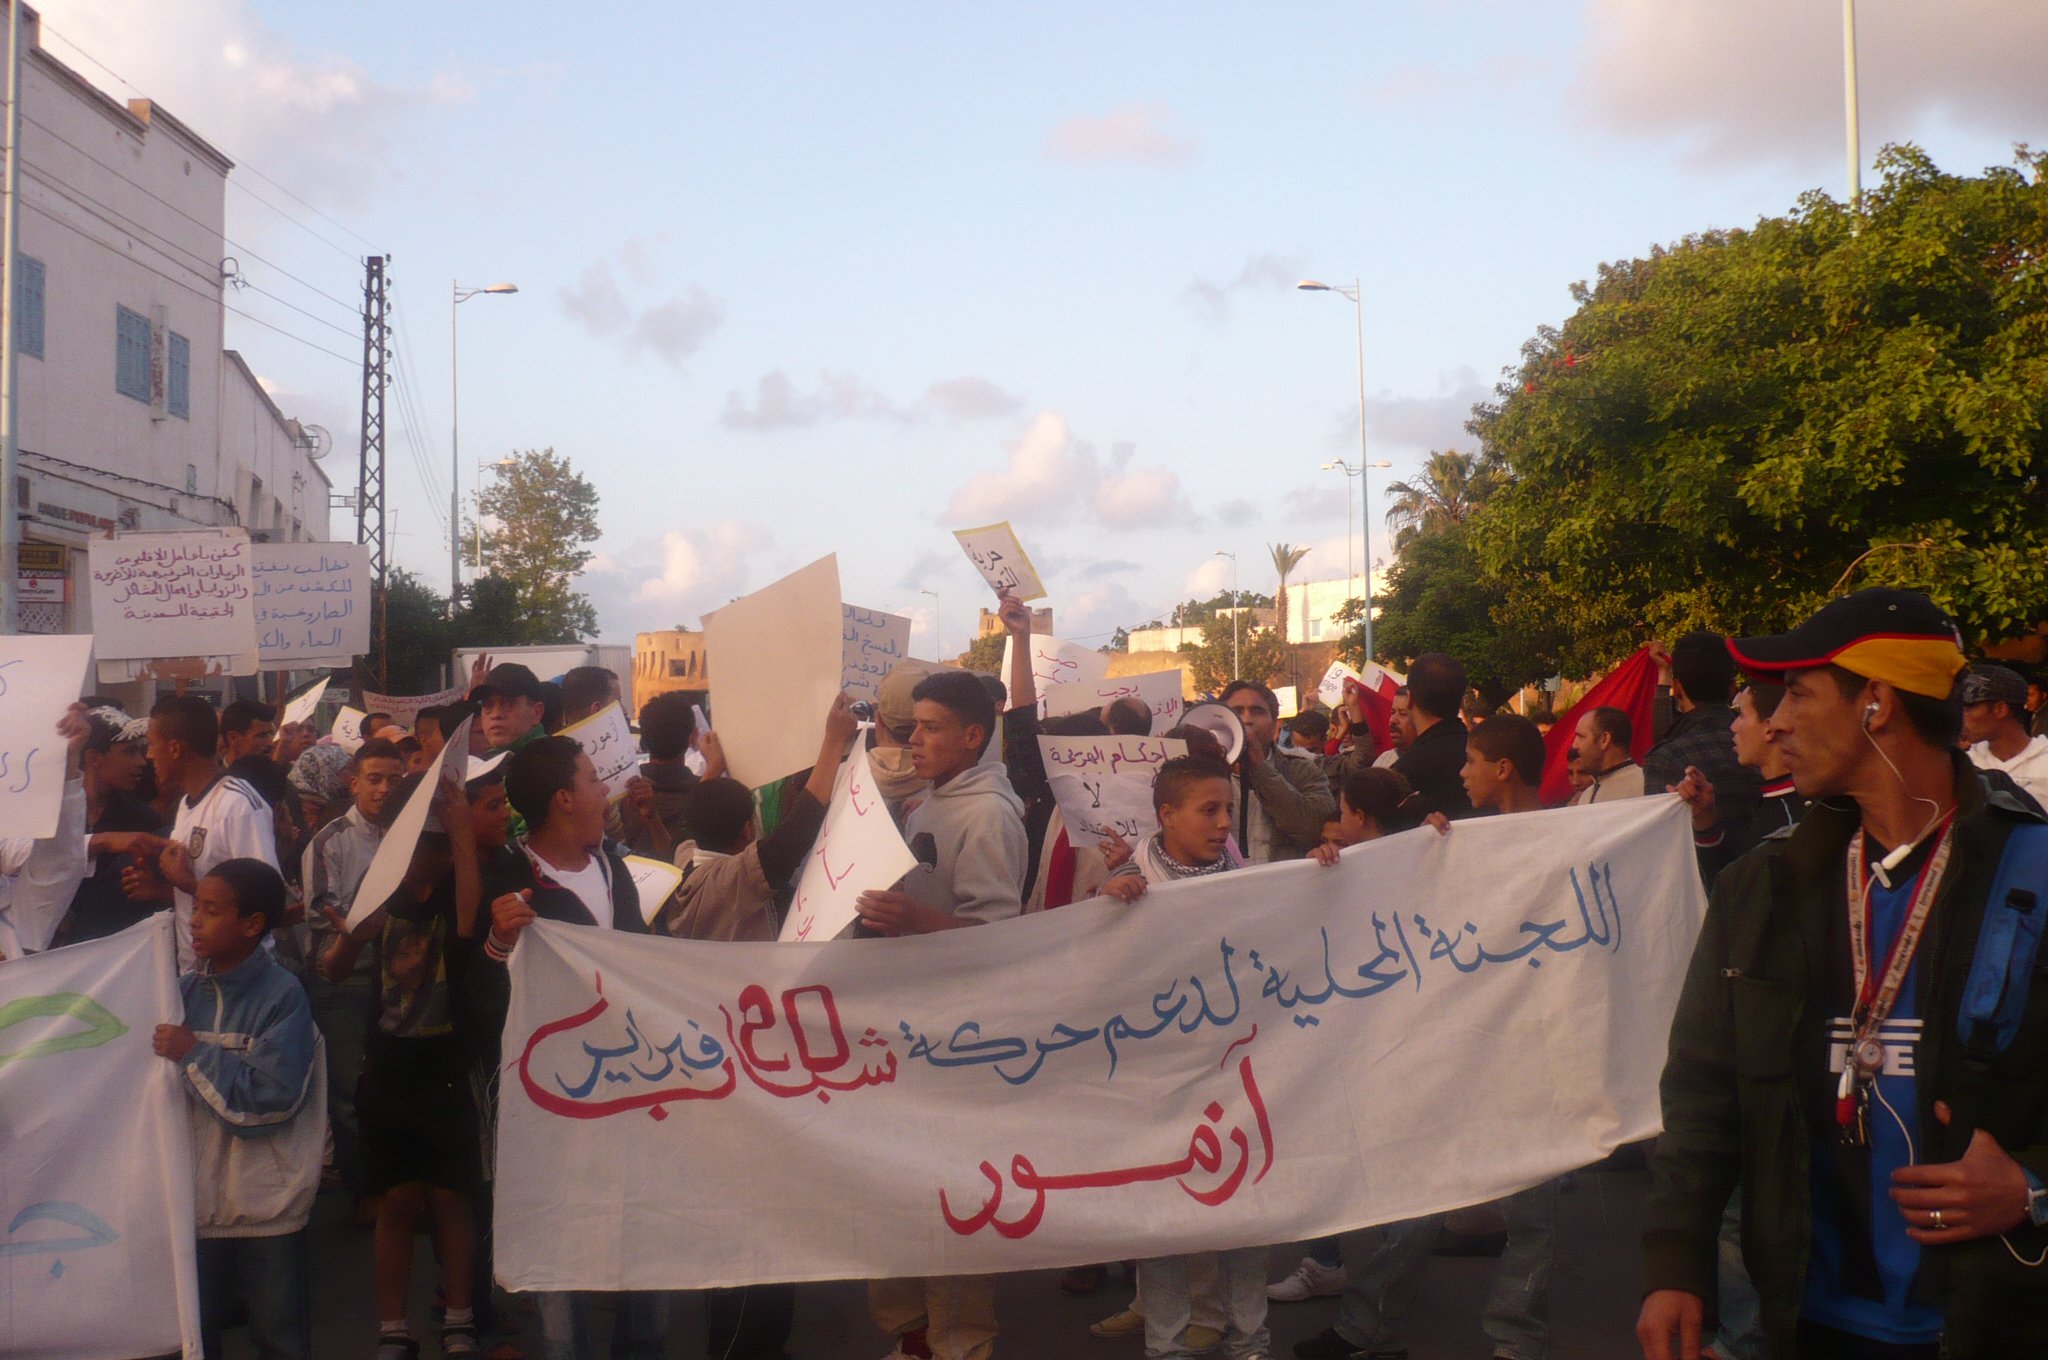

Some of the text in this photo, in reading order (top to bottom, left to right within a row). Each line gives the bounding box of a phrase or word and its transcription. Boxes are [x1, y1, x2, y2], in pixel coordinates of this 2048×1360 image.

[1250, 910, 1421, 1028] المحلية
[1415, 861, 1622, 972] اللجنة
[556, 1007, 724, 1098] فبراير
[899, 1020, 1099, 1085] حركة
[1104, 937, 1241, 1081] لدعم
